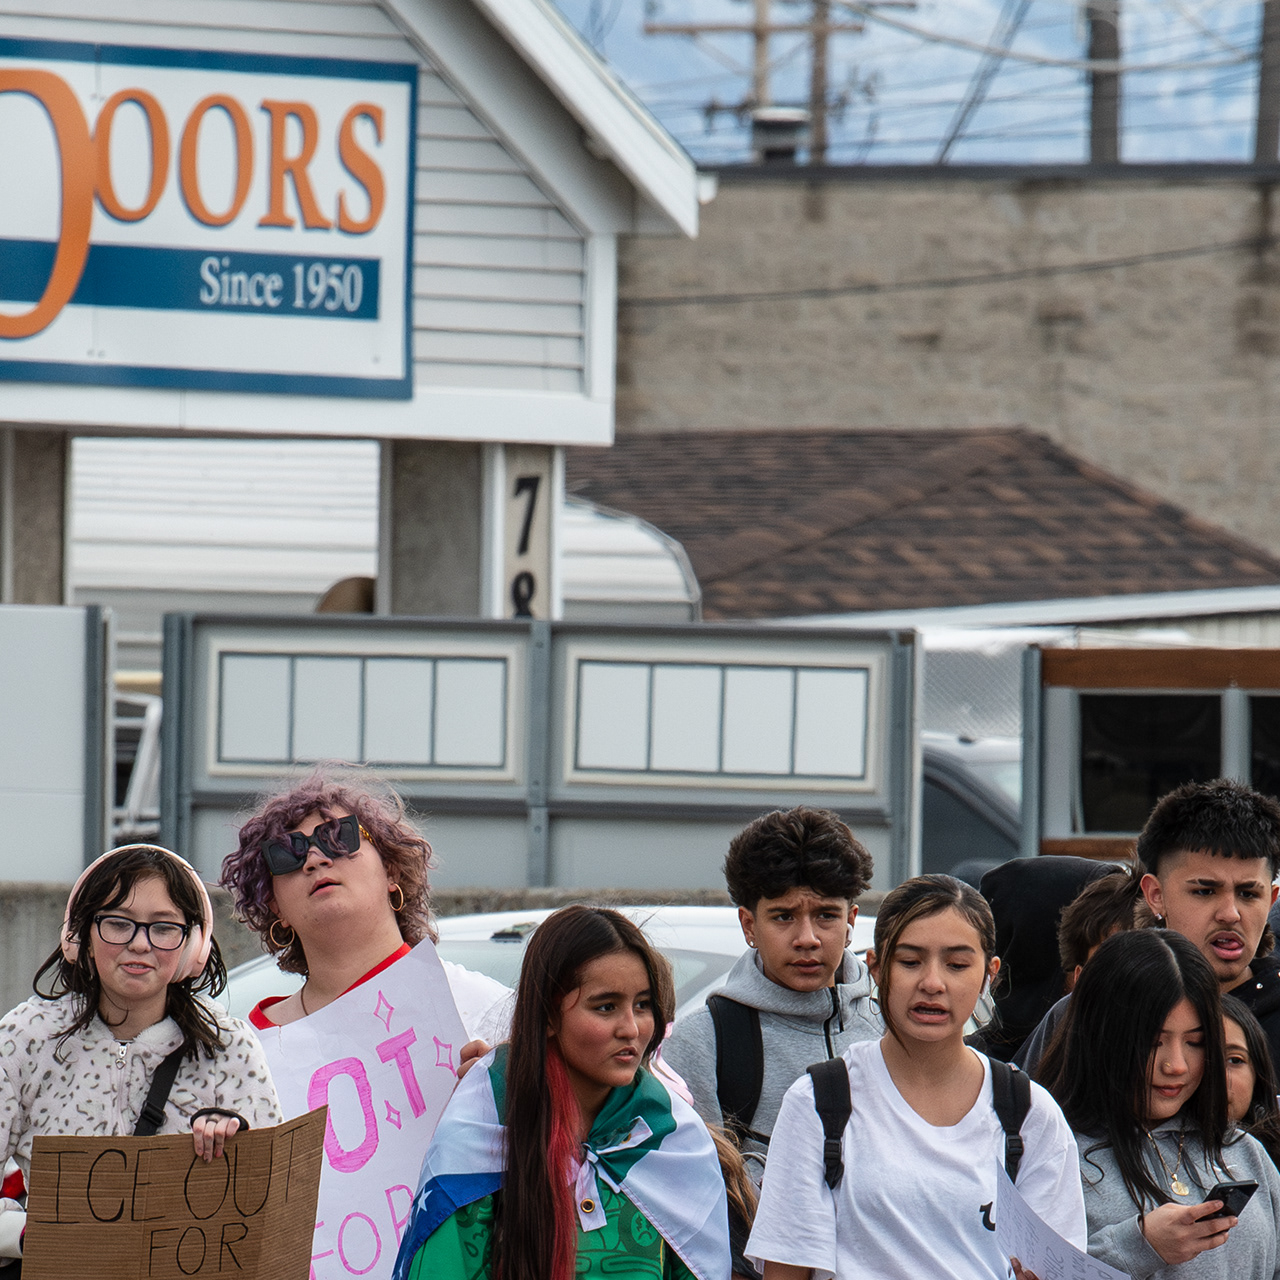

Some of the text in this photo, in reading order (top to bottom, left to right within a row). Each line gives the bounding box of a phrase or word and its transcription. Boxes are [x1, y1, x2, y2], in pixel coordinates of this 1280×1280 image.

[199, 257, 363, 313] Since 1950
[307, 1025, 427, 1174] OT
[35, 1122, 310, 1224] ICE OUT
[148, 1222, 250, 1278] FOR
